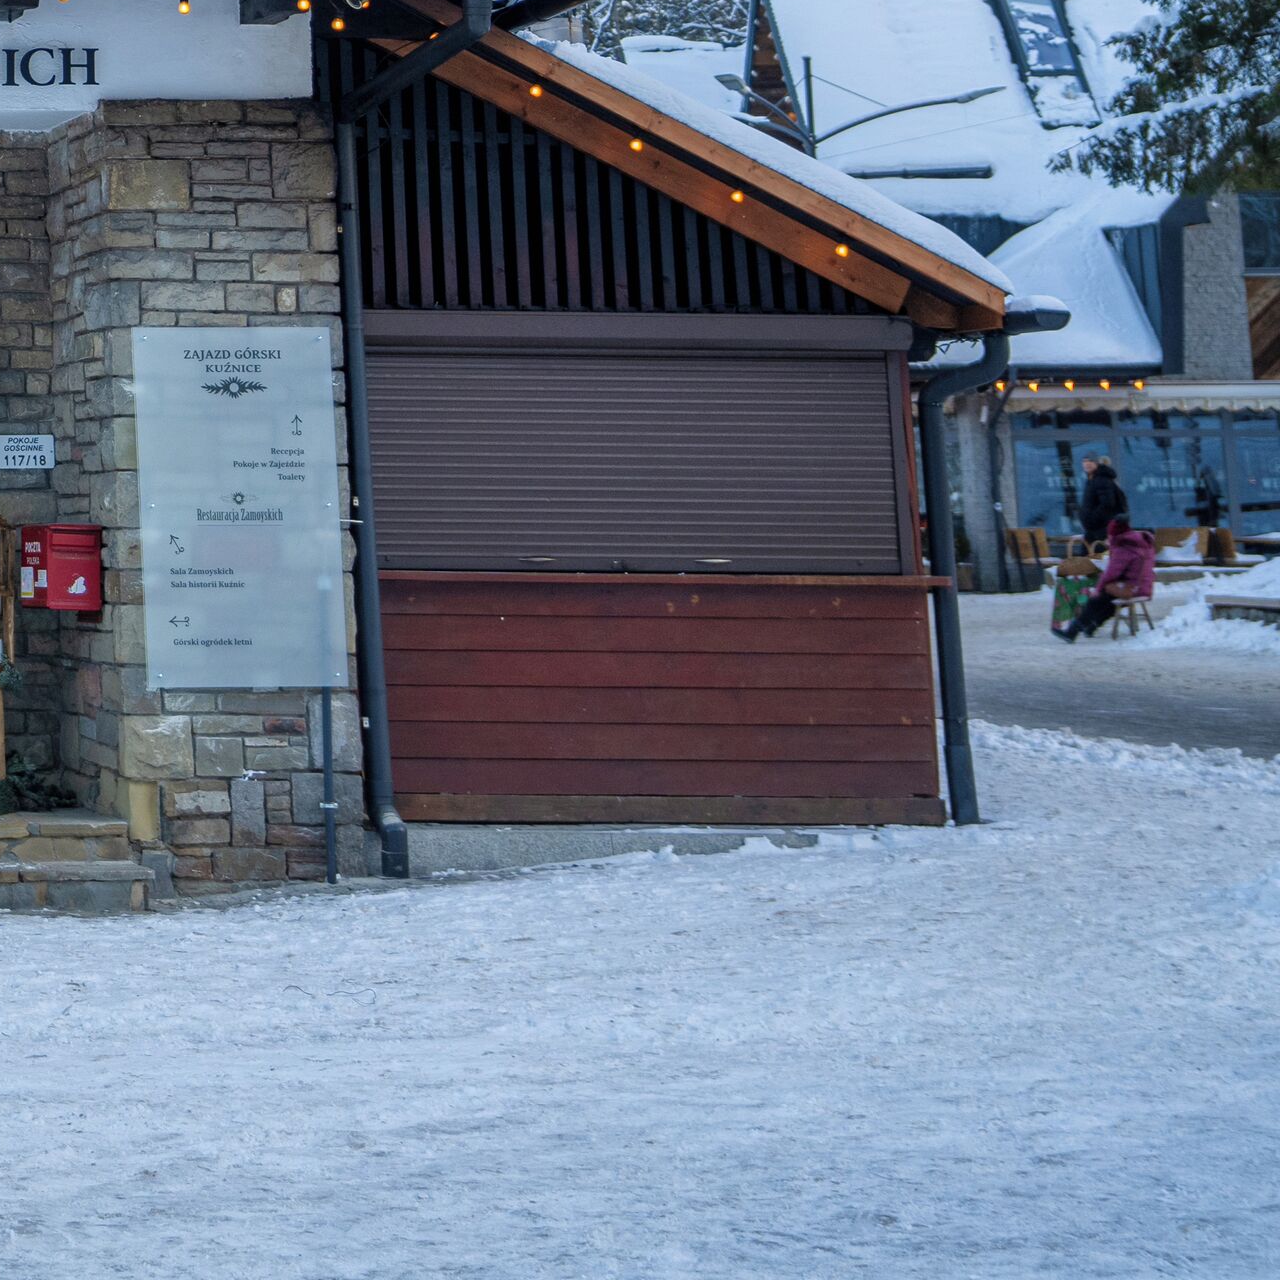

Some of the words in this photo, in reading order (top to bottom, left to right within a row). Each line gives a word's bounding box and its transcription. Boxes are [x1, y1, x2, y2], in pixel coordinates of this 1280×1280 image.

[183, 349, 231, 362] ZAJAZD
[234, 347, 281, 359] GÓRSKI
[205, 362, 262, 373] KUŹNICE
[4, 444, 44, 452] GOŚCINNE
[271, 448, 305, 456] Recepcja
[4, 455, 47, 466] 117/18
[233, 461, 259, 469] Pokoje
[269, 460, 305, 469] Zajeździe
[278, 473, 305, 482] Toalety
[197, 508, 239, 522] Restauracja
[240, 508, 283, 522] Zamoyskich
[188, 568, 234, 576] Zamoyskich
[173, 638, 199, 646] Górski
[200, 638, 233, 648] ogródek
[234, 638, 253, 646] letni
